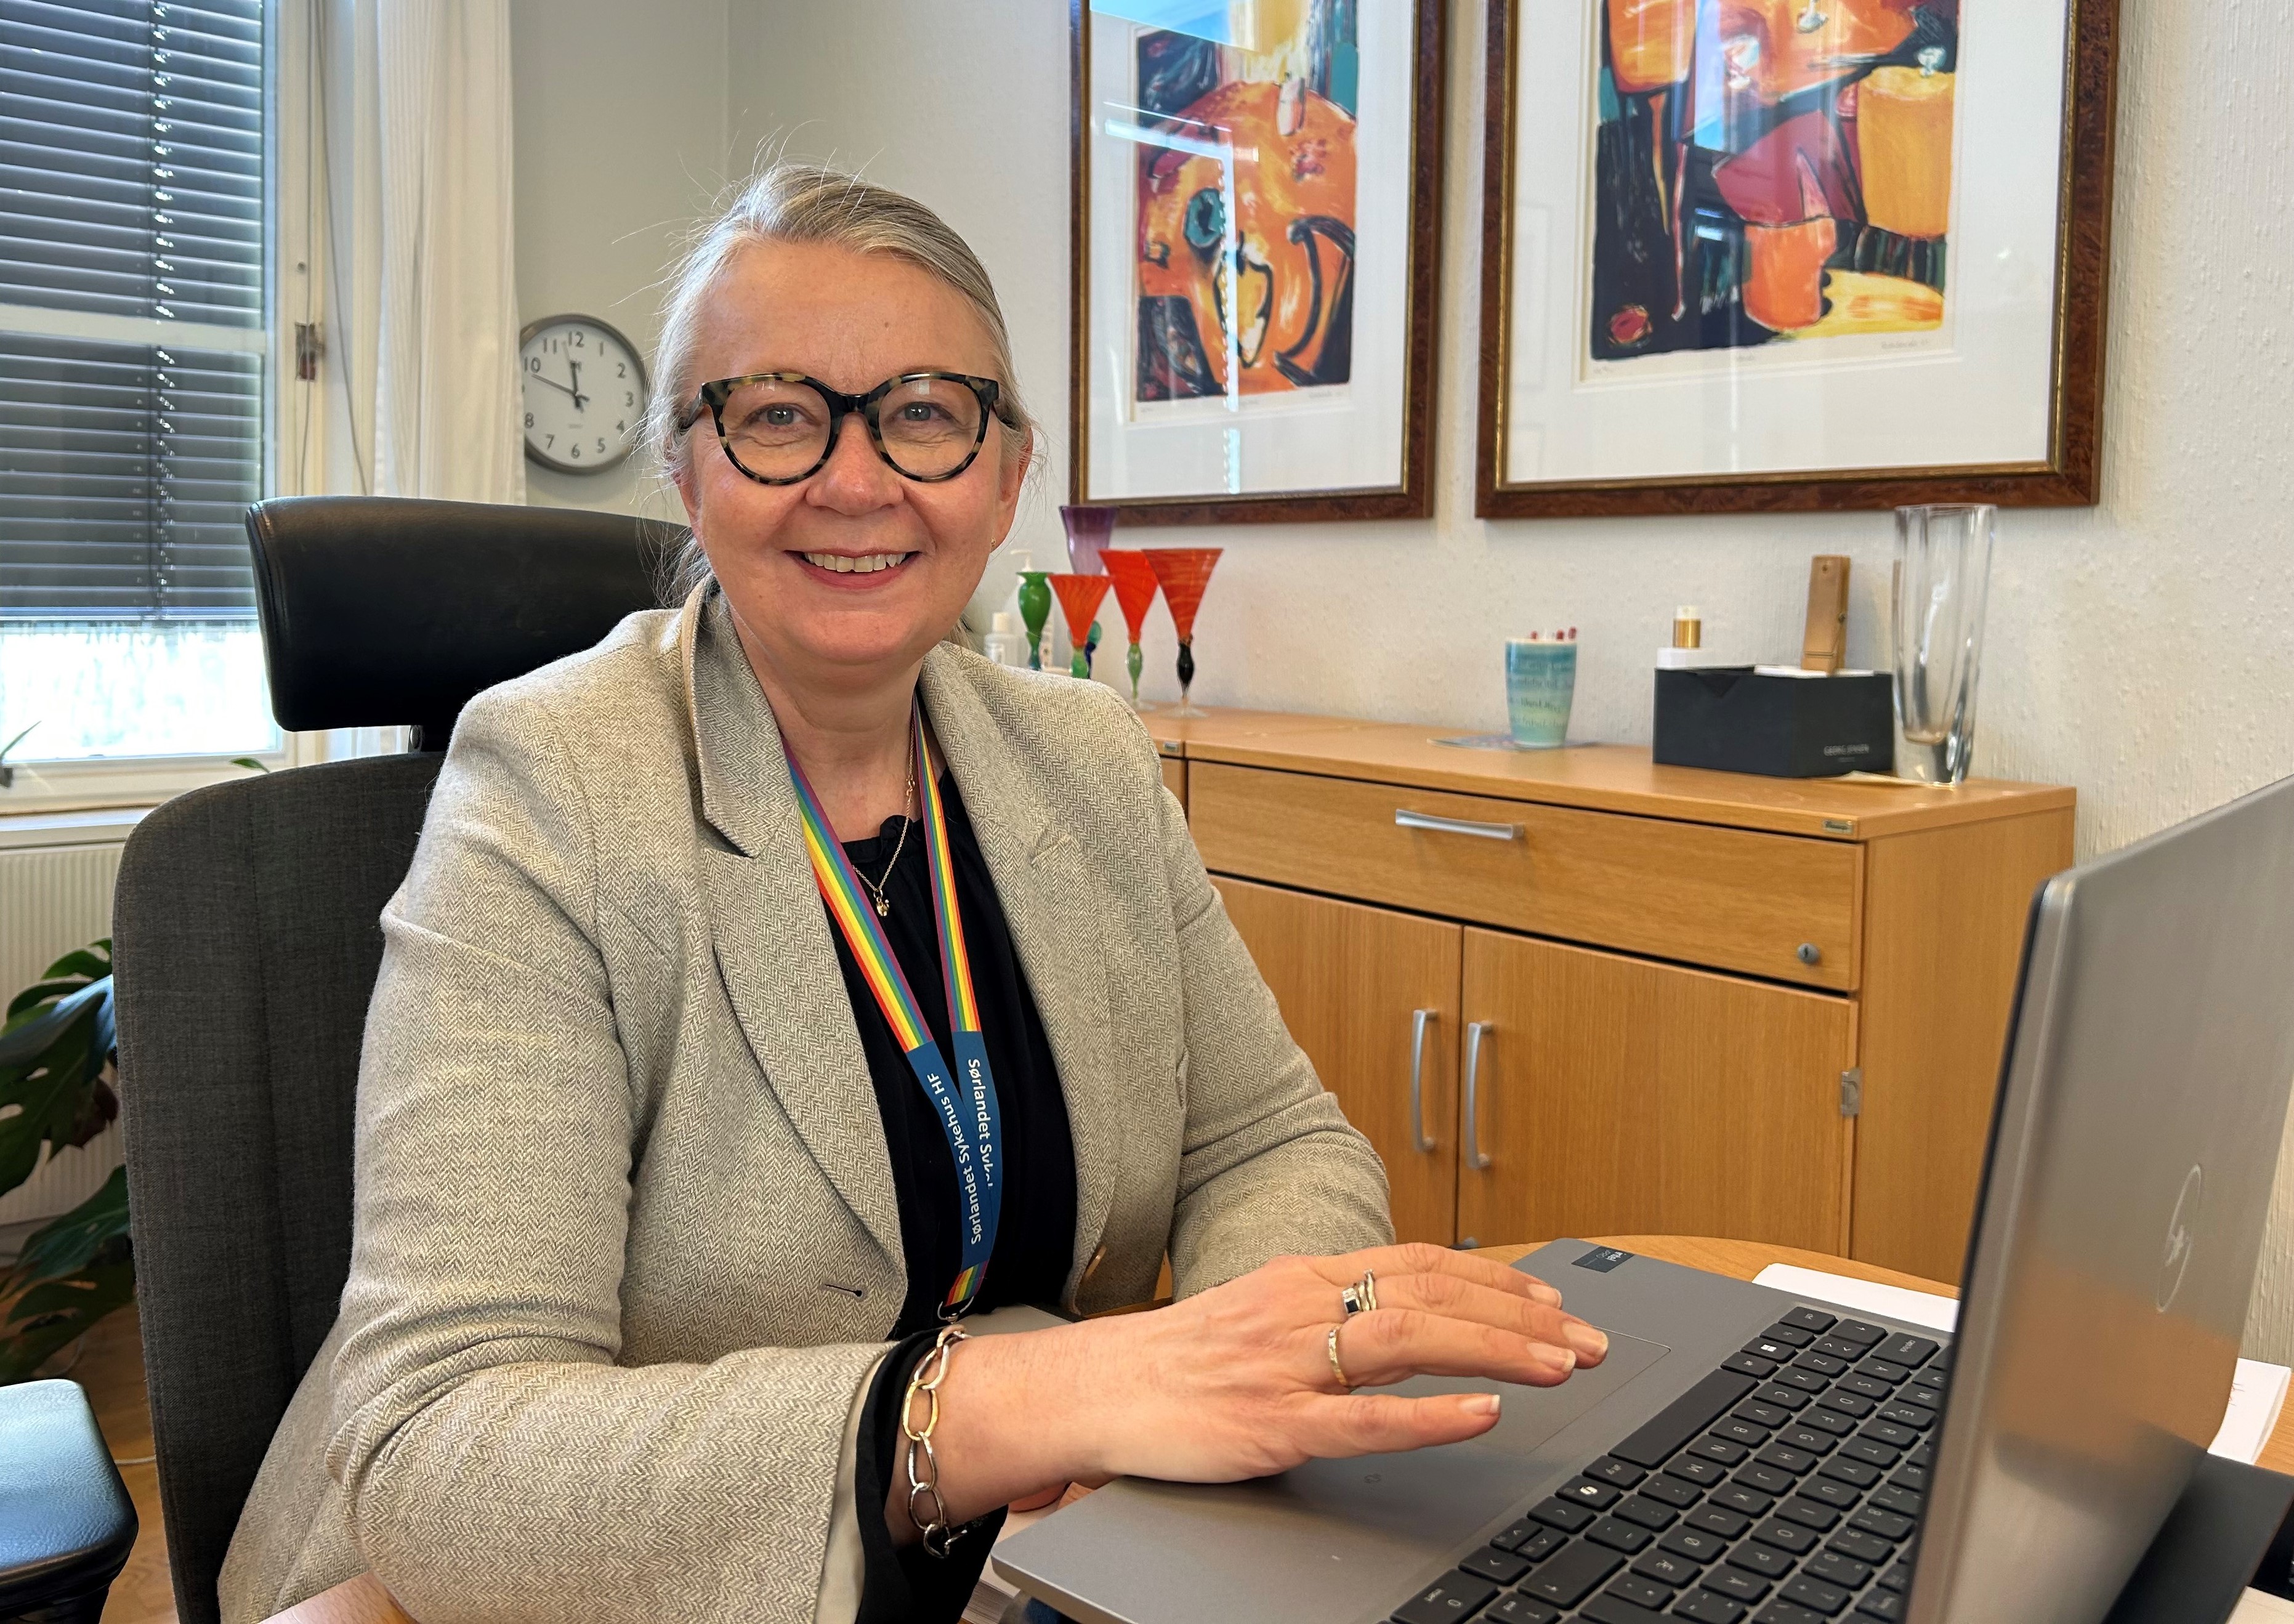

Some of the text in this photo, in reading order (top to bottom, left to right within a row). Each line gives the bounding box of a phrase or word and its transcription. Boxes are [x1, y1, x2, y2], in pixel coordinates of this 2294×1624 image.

[543, 338, 557, 355] 11
[568, 331, 584, 347] 12
[600, 342, 604, 357] 1
[525, 357, 541, 373] 10
[617, 362, 625, 378] 2
[626, 391, 634, 407] 3
[525, 412, 535, 429] 8
[616, 420, 624, 432] 4
[546, 434, 554, 450] 7
[597, 437, 605, 453] 5
[571, 443, 580, 458] 6
[968, 1059, 990, 1139] Sørlandet
[927, 1073, 982, 1245] Sørlandet Sykehus HF
[1687, 1464, 1703, 1473] M
[1684, 1537, 1700, 1546] Ø
[1777, 1530, 1794, 1538] O
[1756, 1553, 1770, 1561] P
[1656, 1560, 1673, 1571] Æ
[1727, 1577, 1748, 1586] Å
